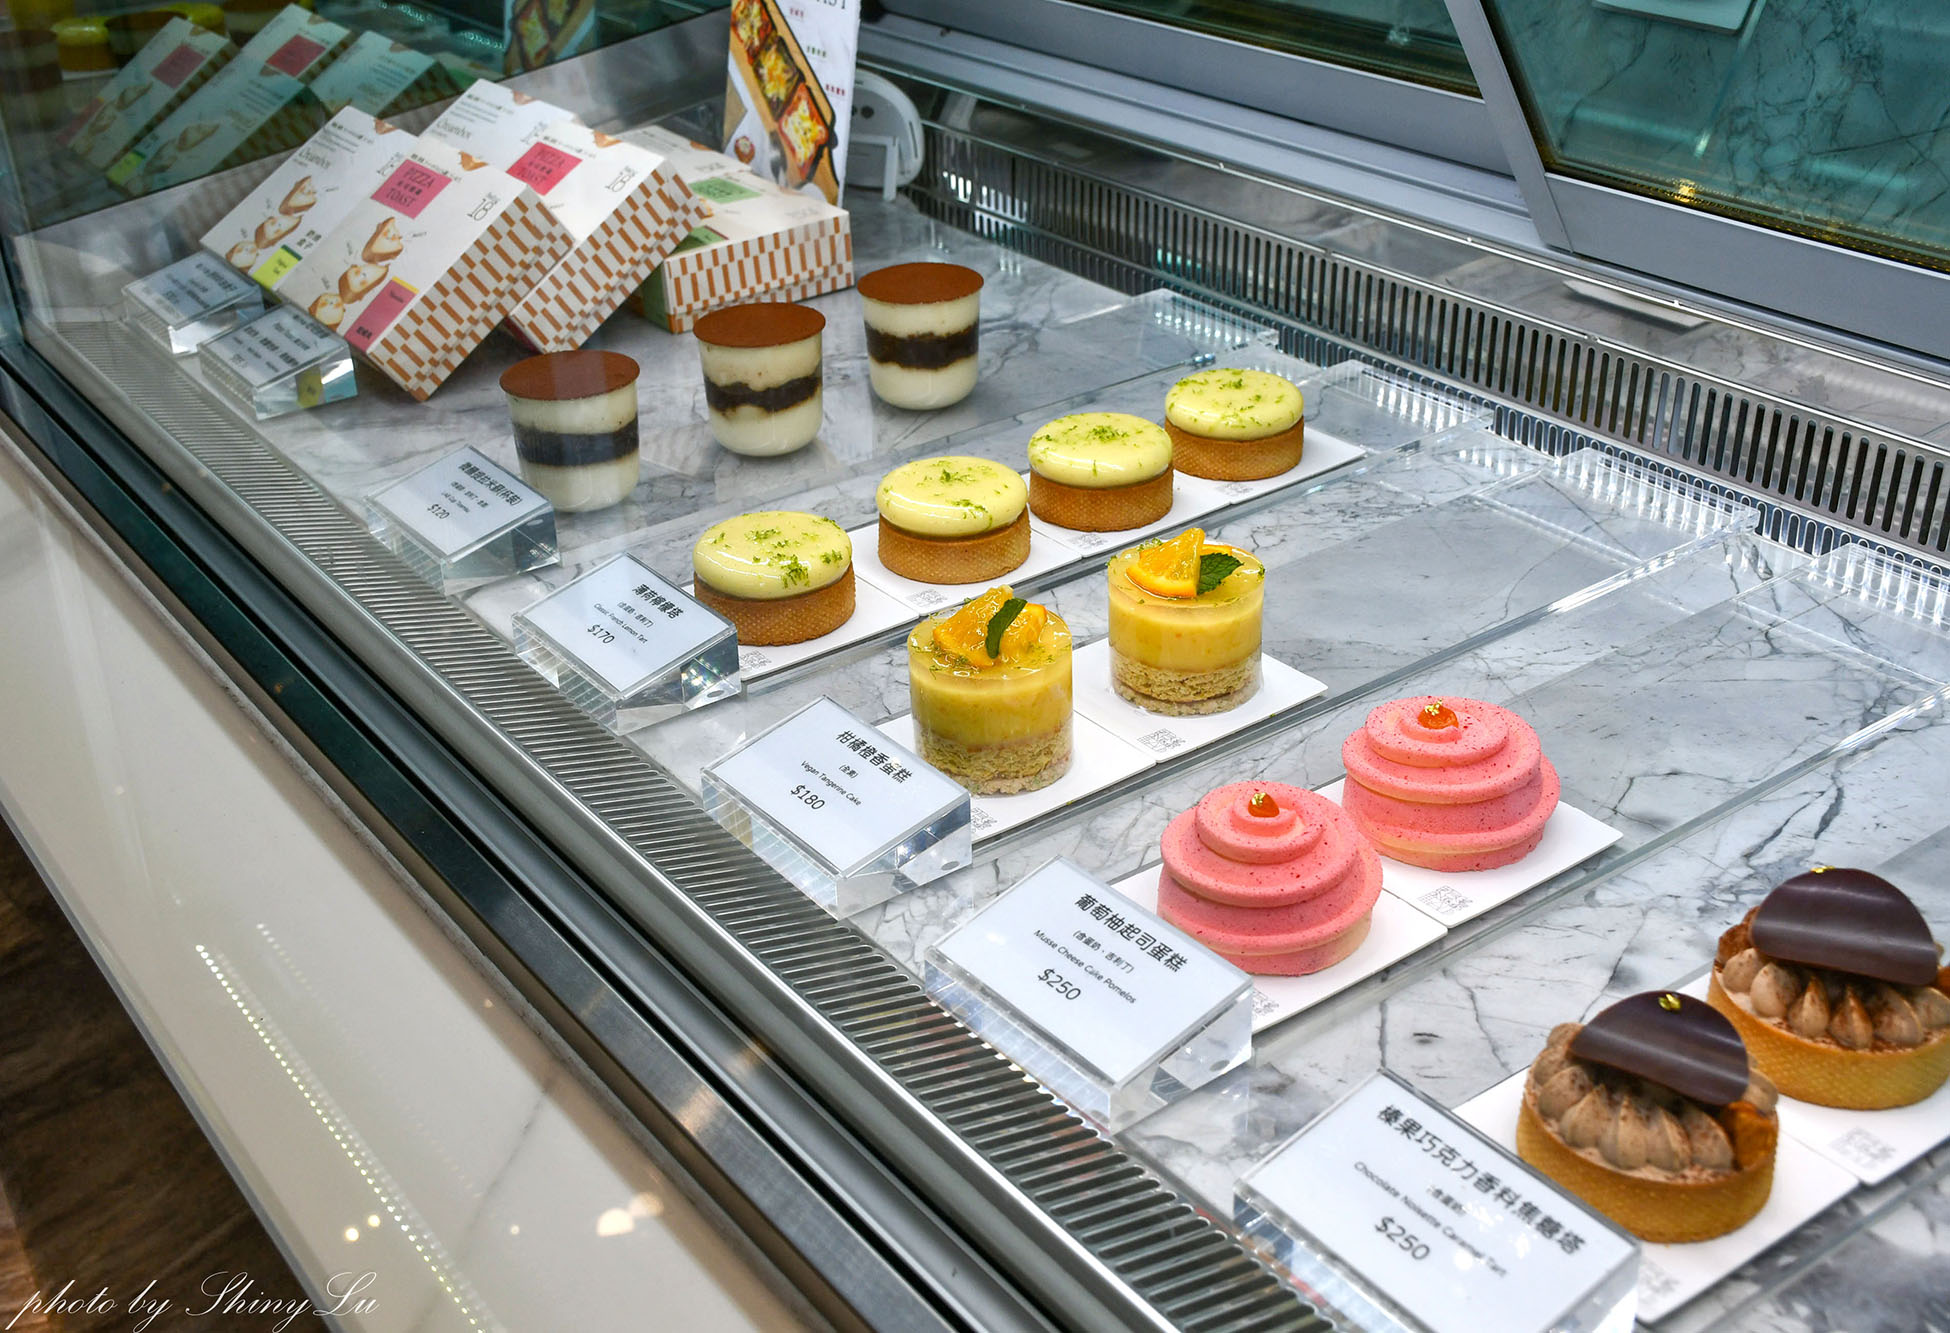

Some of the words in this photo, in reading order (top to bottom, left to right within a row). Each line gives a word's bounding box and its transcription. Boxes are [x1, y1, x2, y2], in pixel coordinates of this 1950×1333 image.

[427, 504, 450, 519] $120
[632, 584, 684, 619] 薄荷檸檬塔
[587, 624, 615, 644] $170
[608, 613, 624, 626] French
[621, 623, 638, 637] Lemon
[637, 634, 648, 644] Tart
[836, 730, 913, 784] 柑橘橙香蛋糕
[838, 765, 859, 779] (全素)
[790, 785, 825, 810] $180
[801, 760, 820, 775] Vegan
[818, 773, 847, 795] Tangerine
[845, 793, 862, 806] Cake
[1074, 893, 1188, 972] 葡萄柚起司蛋糕
[1034, 930, 1058, 949] Musse
[1057, 946, 1085, 968] Cheese
[1084, 965, 1104, 981] Cake
[1103, 978, 1137, 1004] Pomelos
[1037, 968, 1081, 1000] $250
[1377, 1104, 1586, 1255] 榛果巧克力香料焦糖塔
[1354, 1161, 1401, 1198] Chocolate
[1400, 1195, 1442, 1229] Noisette
[1442, 1226, 1486, 1259] Caramel
[1374, 1216, 1431, 1260] $250
